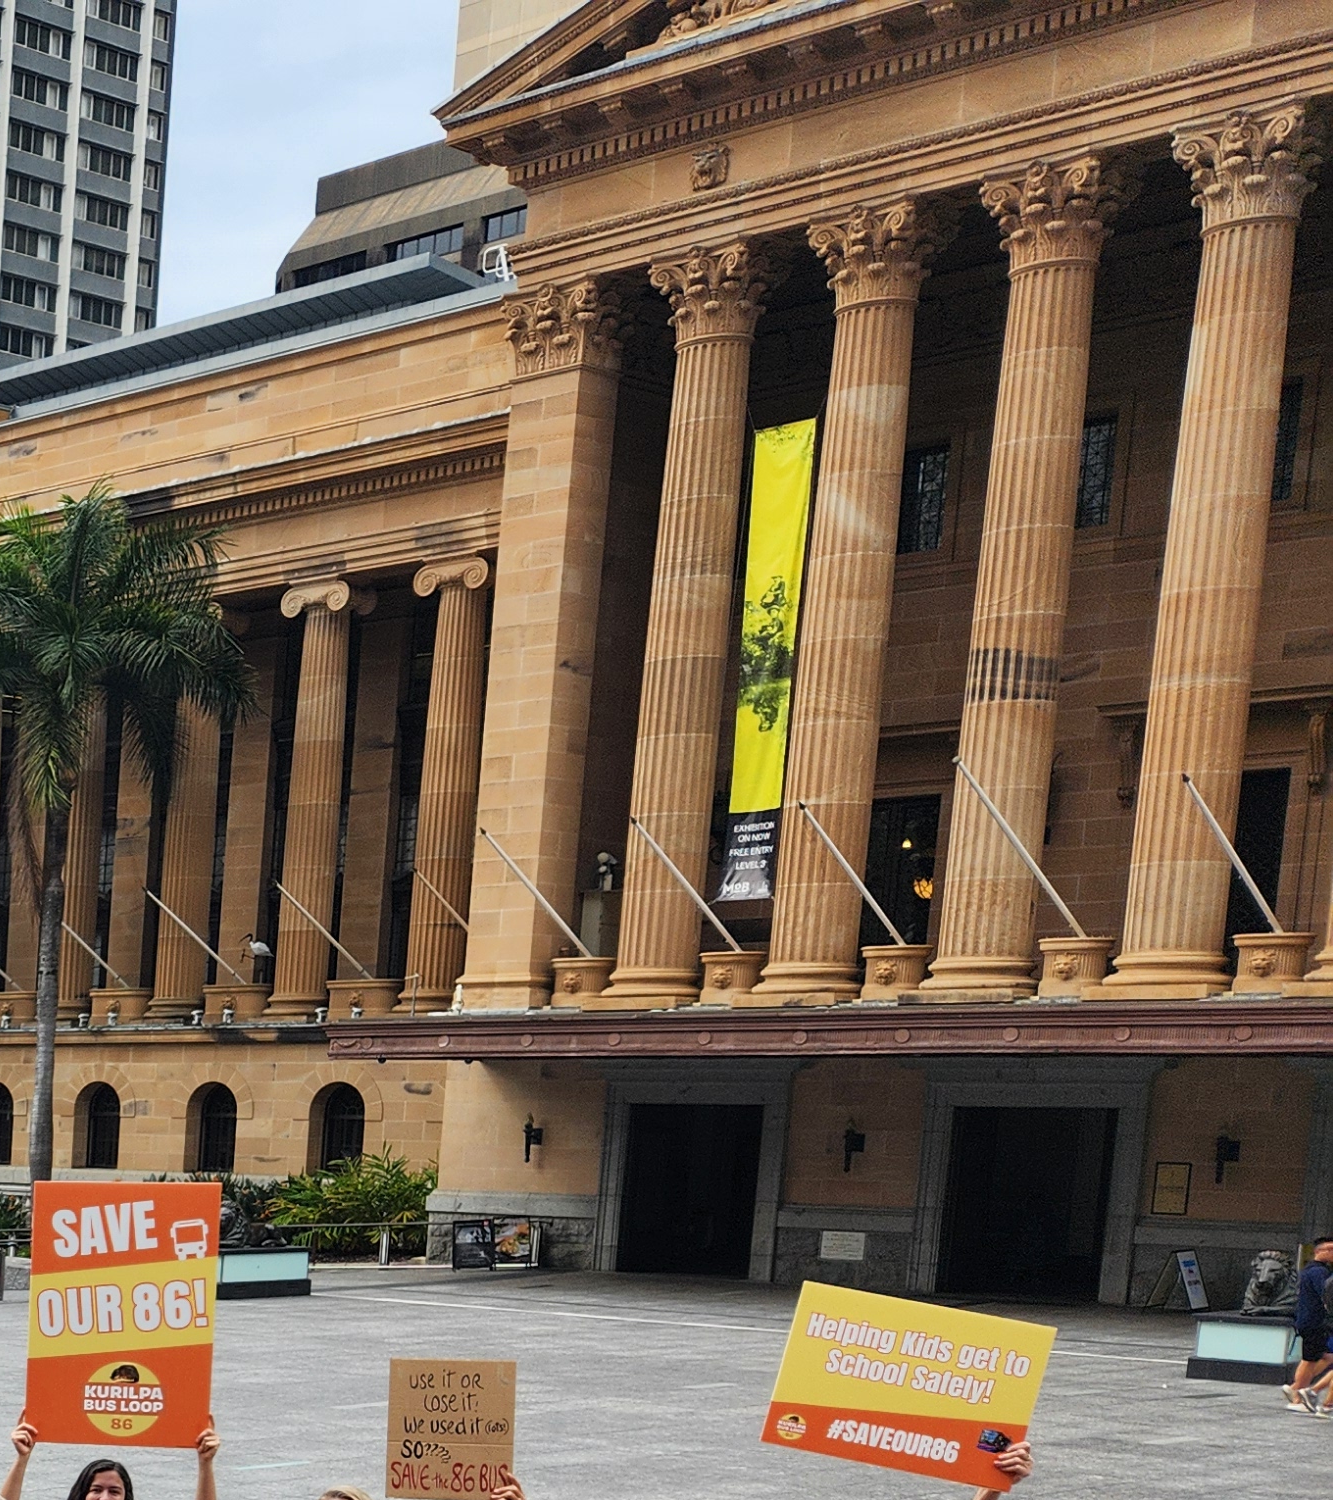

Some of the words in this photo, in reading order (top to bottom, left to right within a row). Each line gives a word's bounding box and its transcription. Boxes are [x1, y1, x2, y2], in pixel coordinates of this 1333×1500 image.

[734, 821, 775, 832] EXHIBITION
[738, 834, 750, 843] ON
[752, 832, 770, 841] NOW
[729, 848, 749, 856] FREE
[751, 845, 773, 855] ENTRY
[736, 861, 758, 870] LEVEL
[759, 860, 767, 868] 3
[51, 1200, 158, 1258] SAVE
[37, 1285, 123, 1337] OUR
[132, 1279, 208, 1331] 86!
[806, 1313, 897, 1354] Helping
[900, 1330, 954, 1363] Kids
[956, 1345, 1001, 1372] get
[1003, 1350, 1031, 1378] to
[443, 1369, 456, 1388] it
[460, 1373, 484, 1389] OR
[825, 1348, 909, 1386] School
[910, 1365, 995, 1404] Safely!
[84, 1385, 164, 1401] KURILPA
[83, 1400, 117, 1412] BUS
[120, 1400, 164, 1413] LOOP
[111, 1418, 132, 1430] 86
[404, 1416, 425, 1434] We
[430, 1417, 467, 1435] used
[470, 1417, 483, 1435] it
[826, 1419, 960, 1463] #SAVEOUR86
[391, 1461, 431, 1490] SAVE
[432, 1472, 449, 1489] the
[451, 1463, 475, 1492] 86
[479, 1464, 508, 1492] BUS
